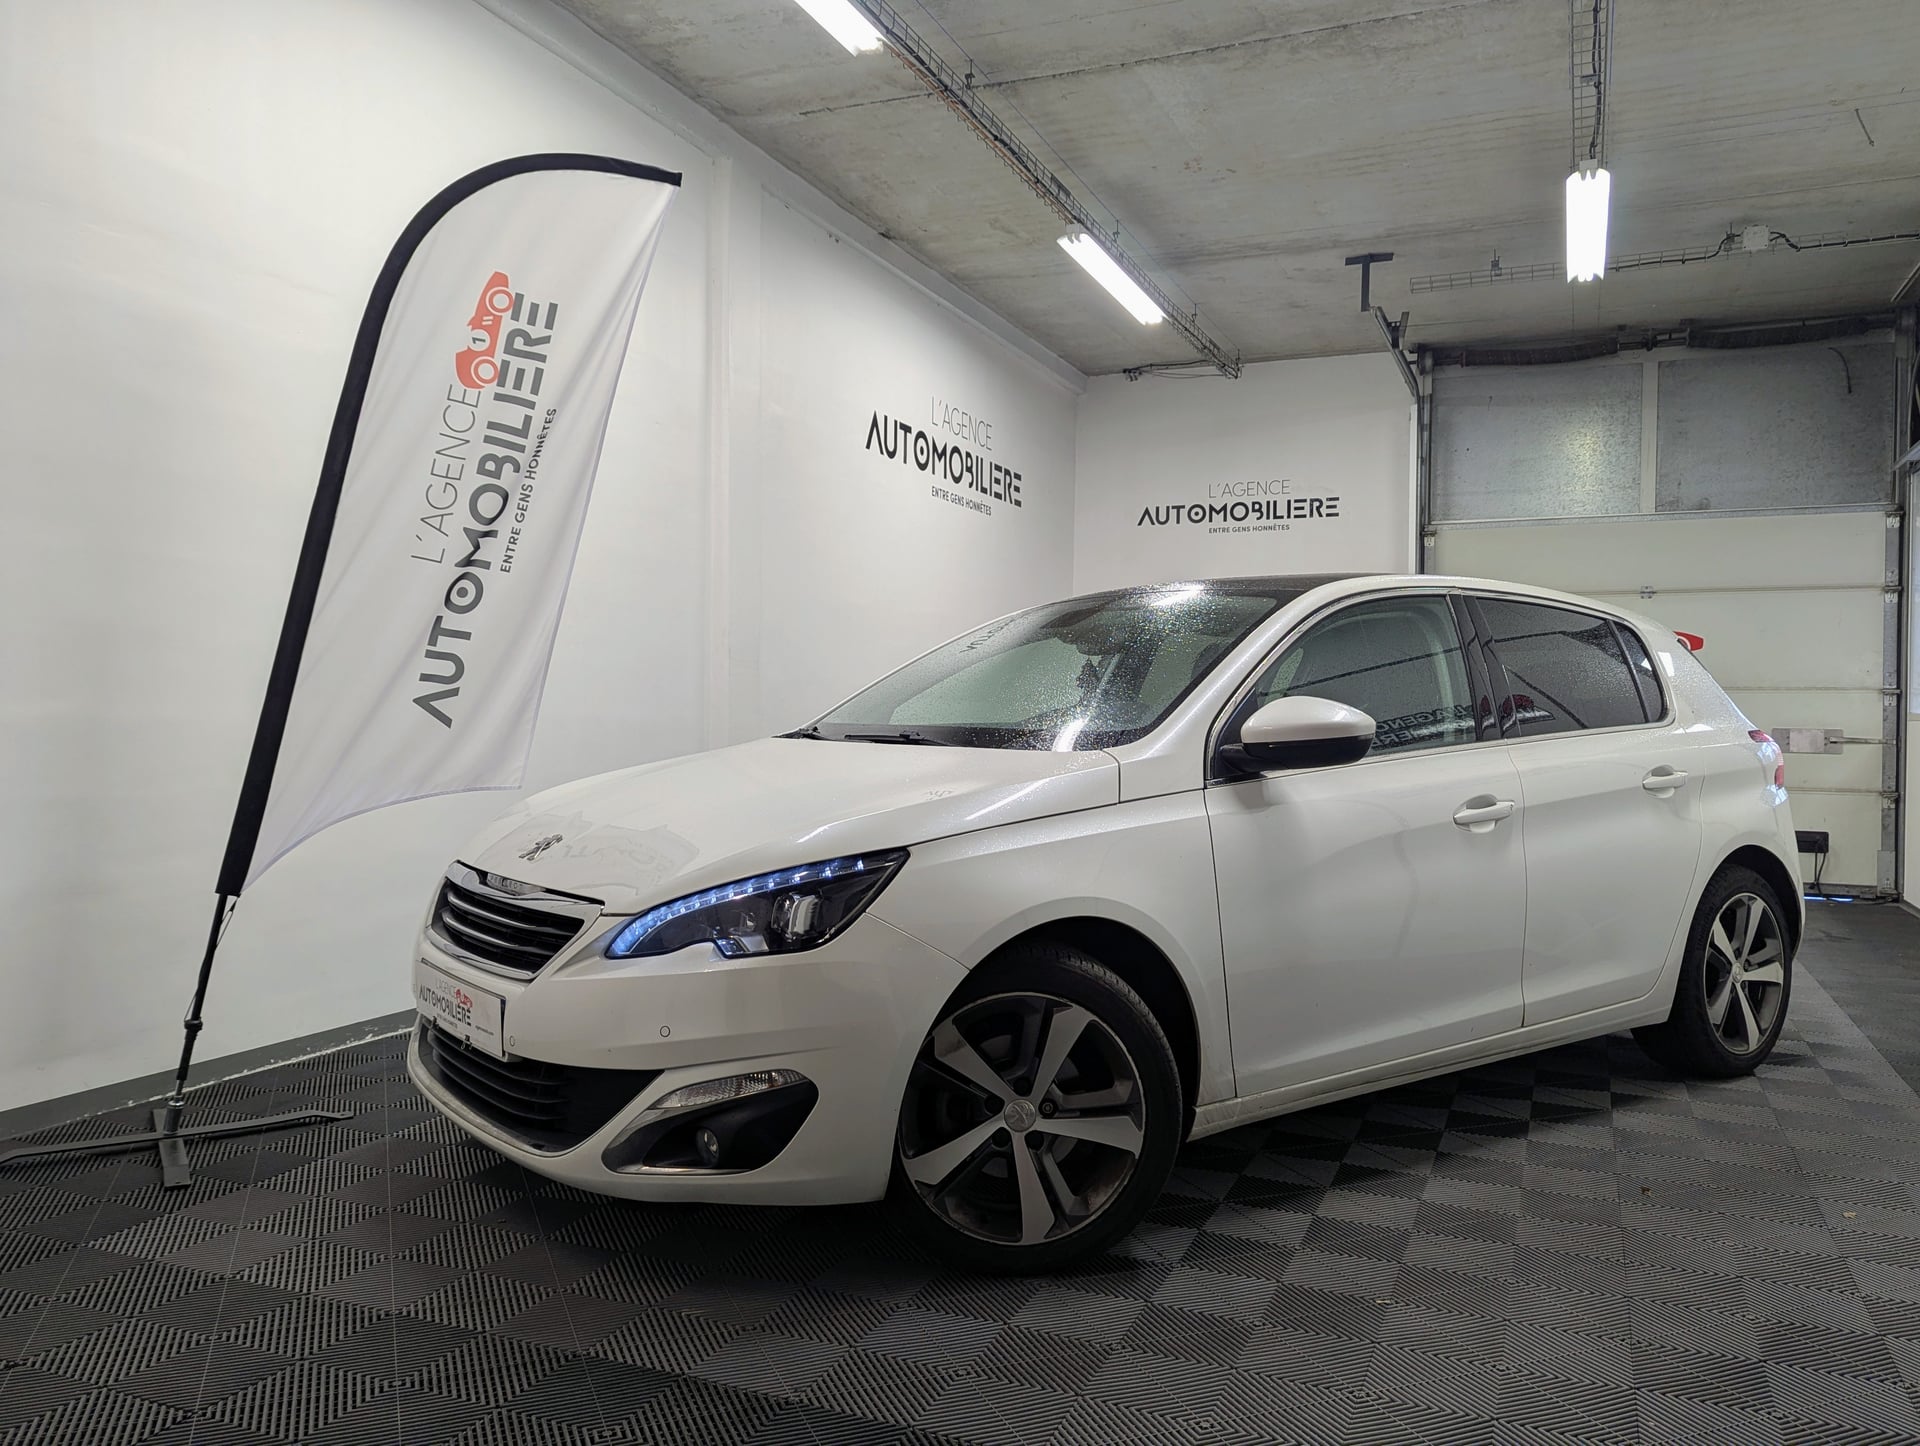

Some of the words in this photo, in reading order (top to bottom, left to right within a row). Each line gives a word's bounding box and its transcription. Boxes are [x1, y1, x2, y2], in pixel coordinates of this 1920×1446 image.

[931, 395, 993, 451] L'AGENCE
[410, 384, 482, 565] L'AGENCE
[865, 409, 1022, 508] AUTOMOBILIERE
[412, 292, 559, 729] AUTOMOBILIERE
[500, 526, 522, 574] ENTRE
[514, 483, 534, 524] GENS
[524, 407, 557, 481] HONNÊTES
[931, 485, 950, 502] ENTRE
[949, 492, 965, 508] GENS
[965, 499, 992, 516] HONNÊTES
[1137, 496, 1340, 527] AUTOMOBILIERE
[1208, 479, 1291, 499] L'AGENCE
[1208, 526, 1231, 534] ENTRE
[1231, 525, 1251, 533] GENS
[1252, 523, 1291, 533] HONNÊTES
